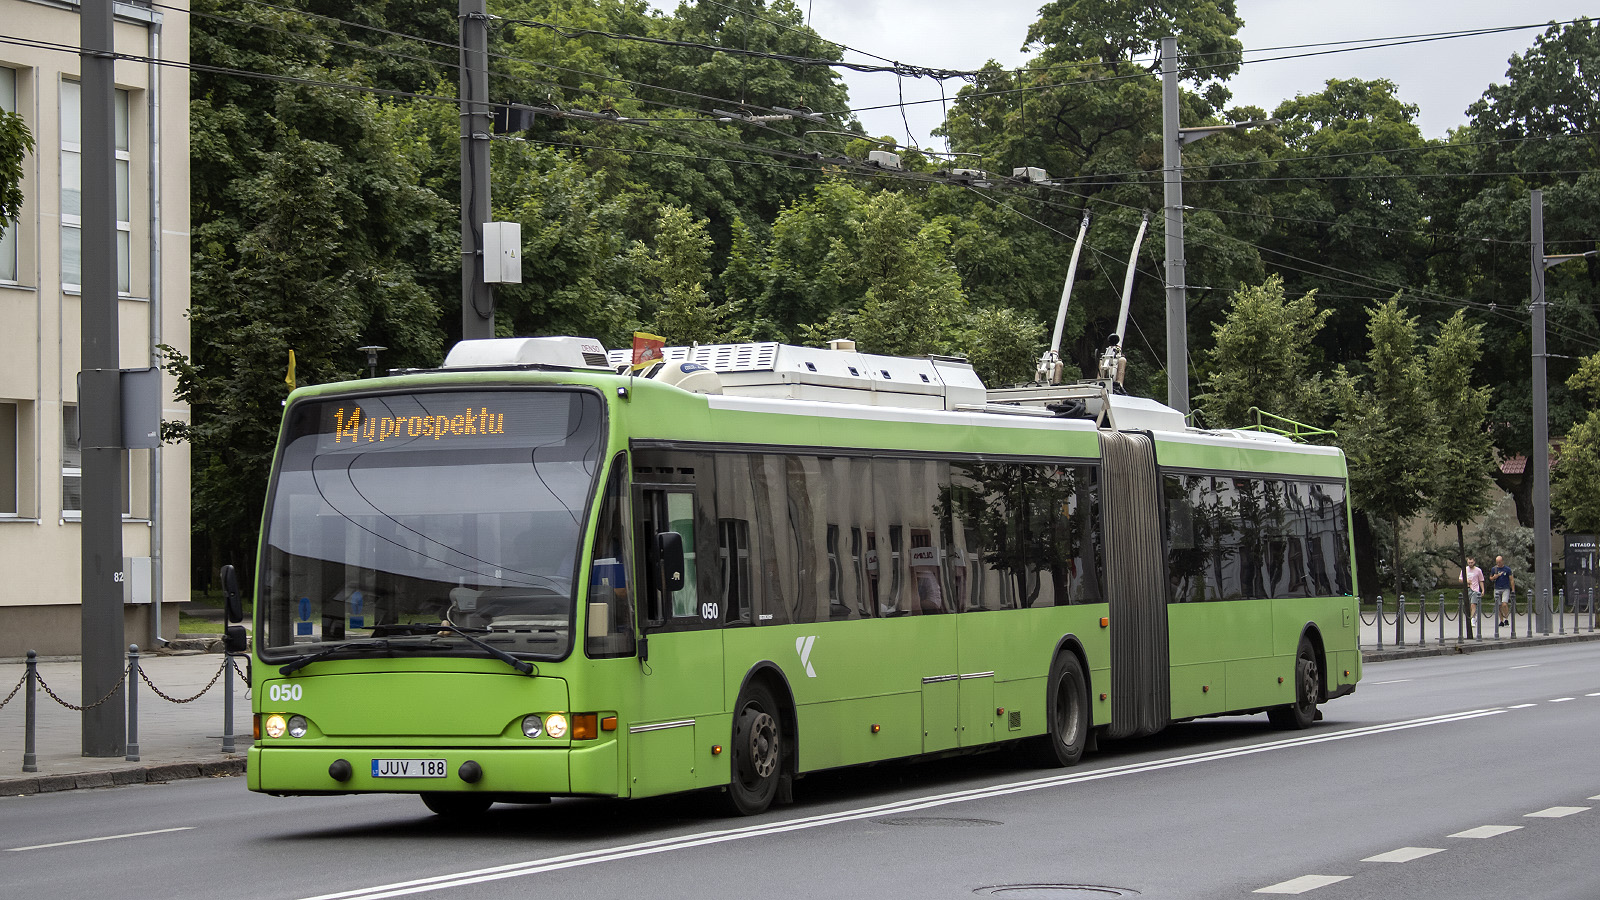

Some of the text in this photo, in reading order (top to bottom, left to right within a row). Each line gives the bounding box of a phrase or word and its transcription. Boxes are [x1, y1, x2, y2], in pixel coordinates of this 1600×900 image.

[581, 344, 600, 353] DENSO
[334, 407, 361, 443] 14
[379, 407, 505, 441] prospektu
[114, 572, 124, 582] 82
[702, 602, 718, 619] 050
[270, 684, 303, 701] 050
[380, 761, 444, 775] JUV 188
